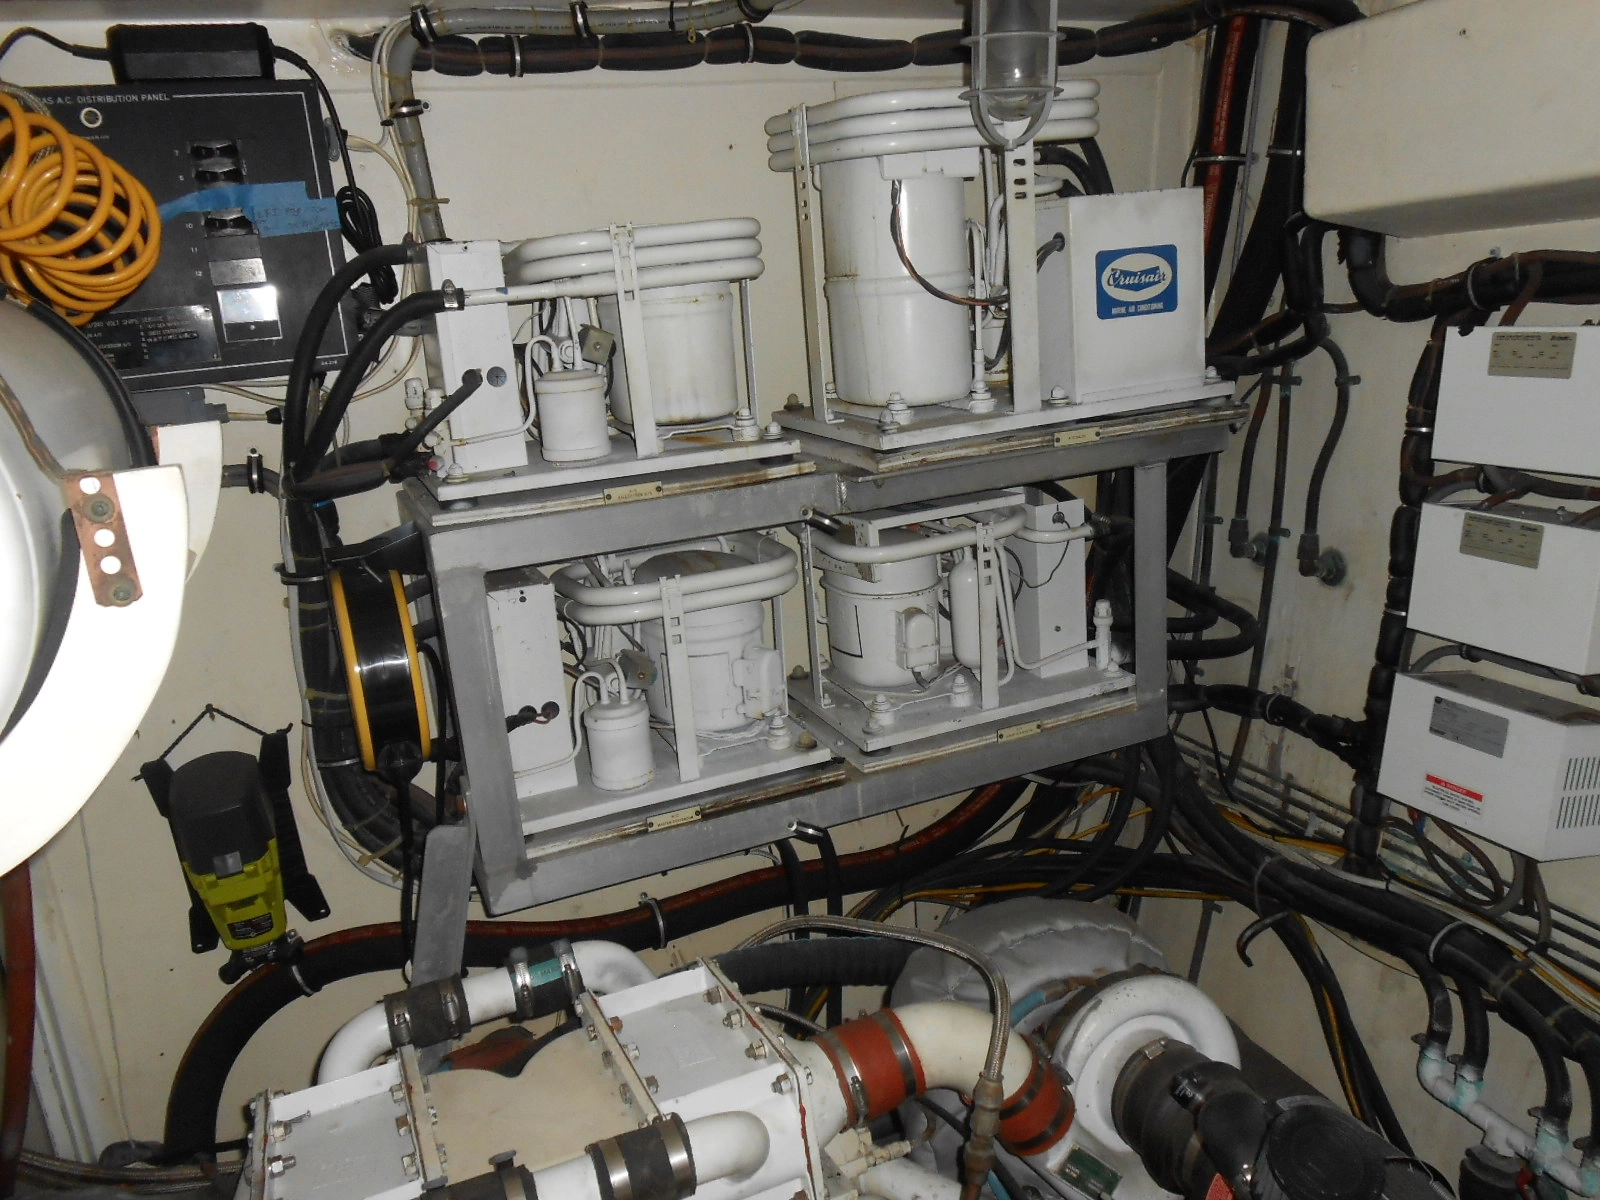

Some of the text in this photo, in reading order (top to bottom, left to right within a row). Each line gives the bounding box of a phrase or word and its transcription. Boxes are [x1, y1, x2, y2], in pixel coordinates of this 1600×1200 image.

[77, 94, 138, 104] DISTRIBUTION
[141, 93, 170, 101] PANEL
[1107, 269, 1166, 286] Cruisair
[1138, 302, 1163, 312] CONDITIONING
